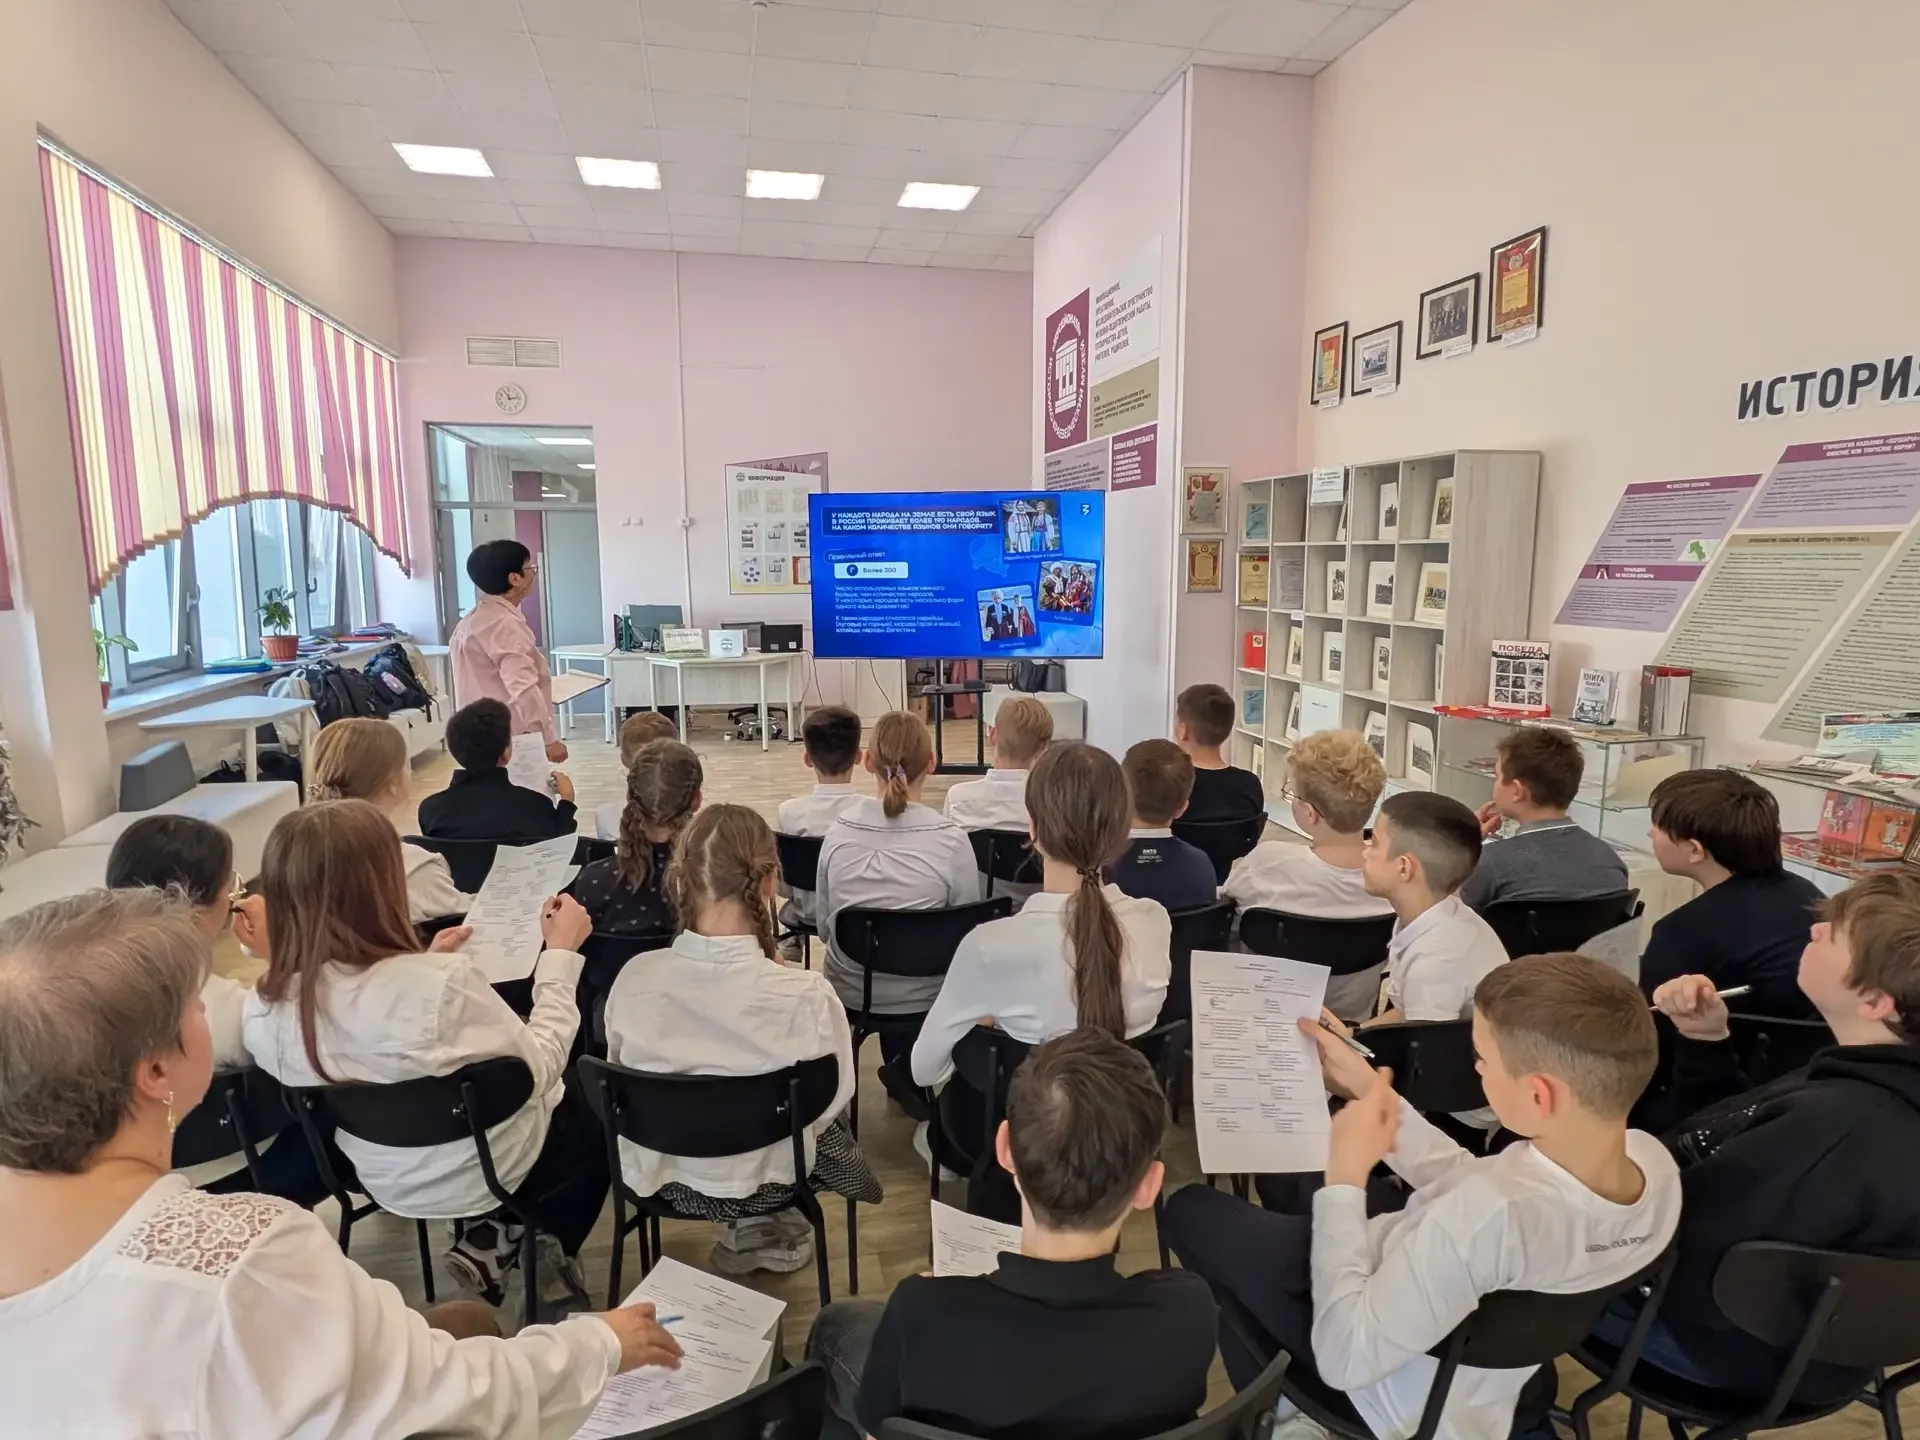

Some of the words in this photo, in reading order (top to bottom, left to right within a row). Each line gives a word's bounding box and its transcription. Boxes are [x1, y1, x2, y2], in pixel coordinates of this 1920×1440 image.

[828, 552, 866, 560] Правильный
[1499, 645, 1543, 653] ПОБЕДА
[1583, 673, 1605, 683] КНИГА
